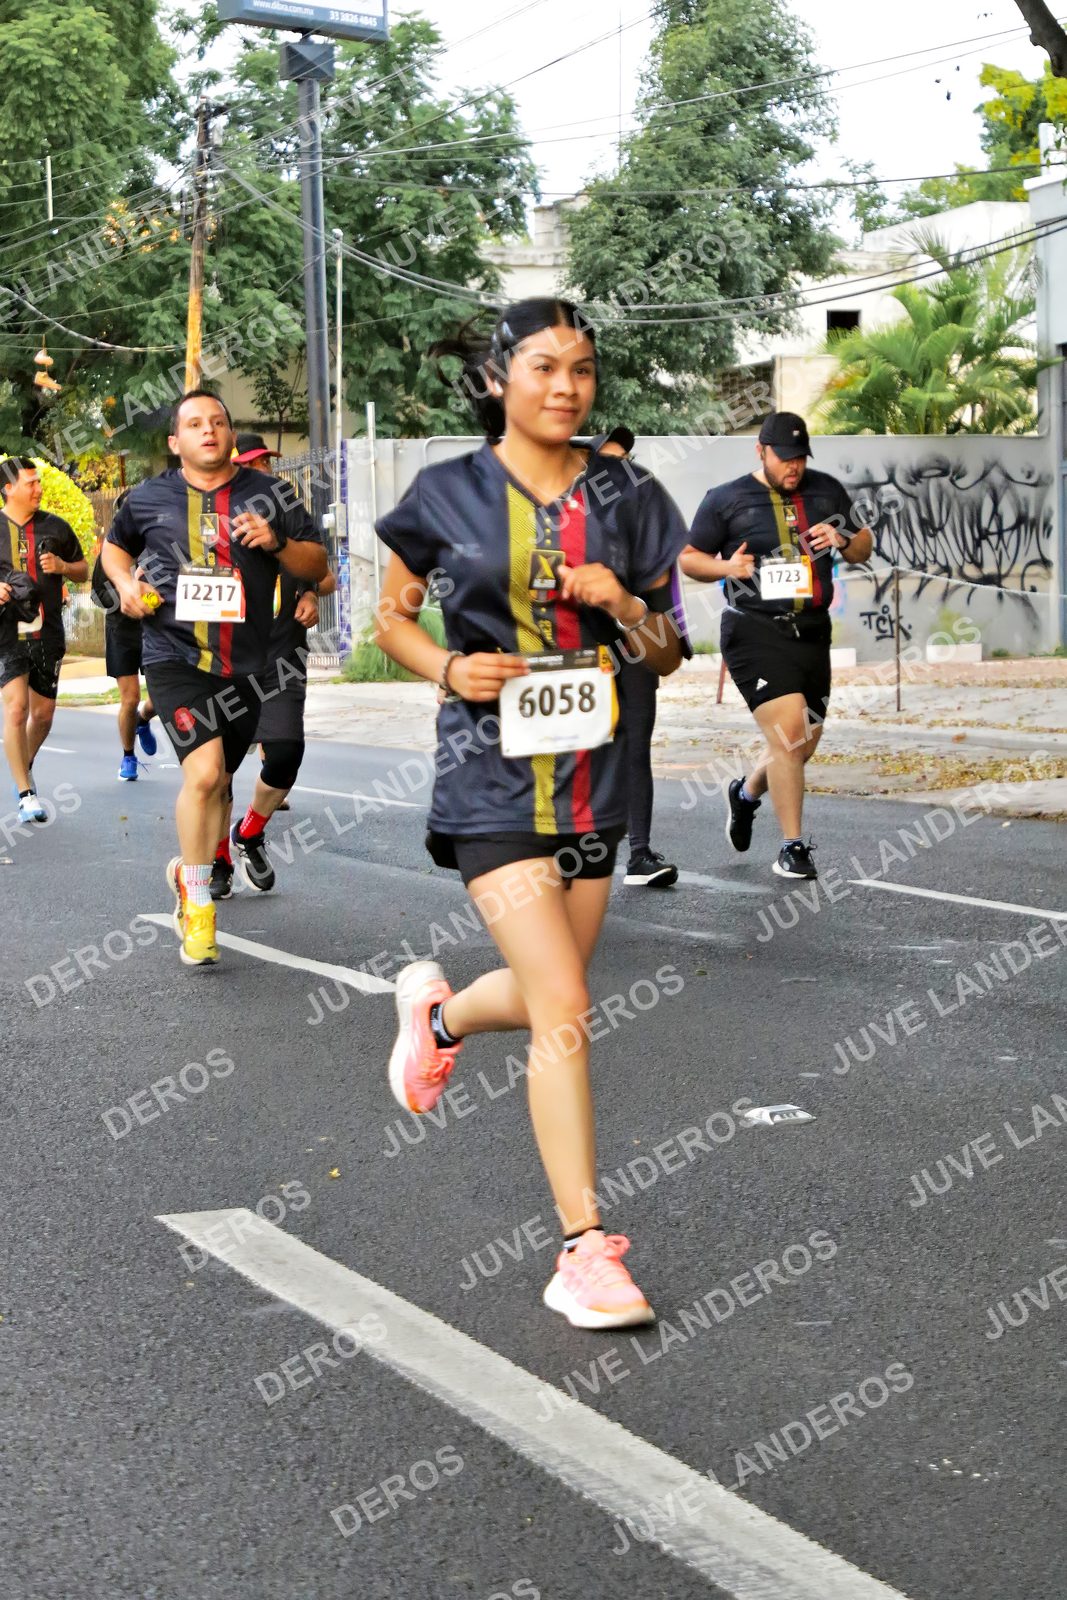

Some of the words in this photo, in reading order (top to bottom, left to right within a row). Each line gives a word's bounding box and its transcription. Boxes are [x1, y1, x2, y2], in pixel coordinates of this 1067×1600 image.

[768, 570, 800, 583] 1723
[182, 584, 236, 601] 12217
[518, 680, 596, 718] 6058
